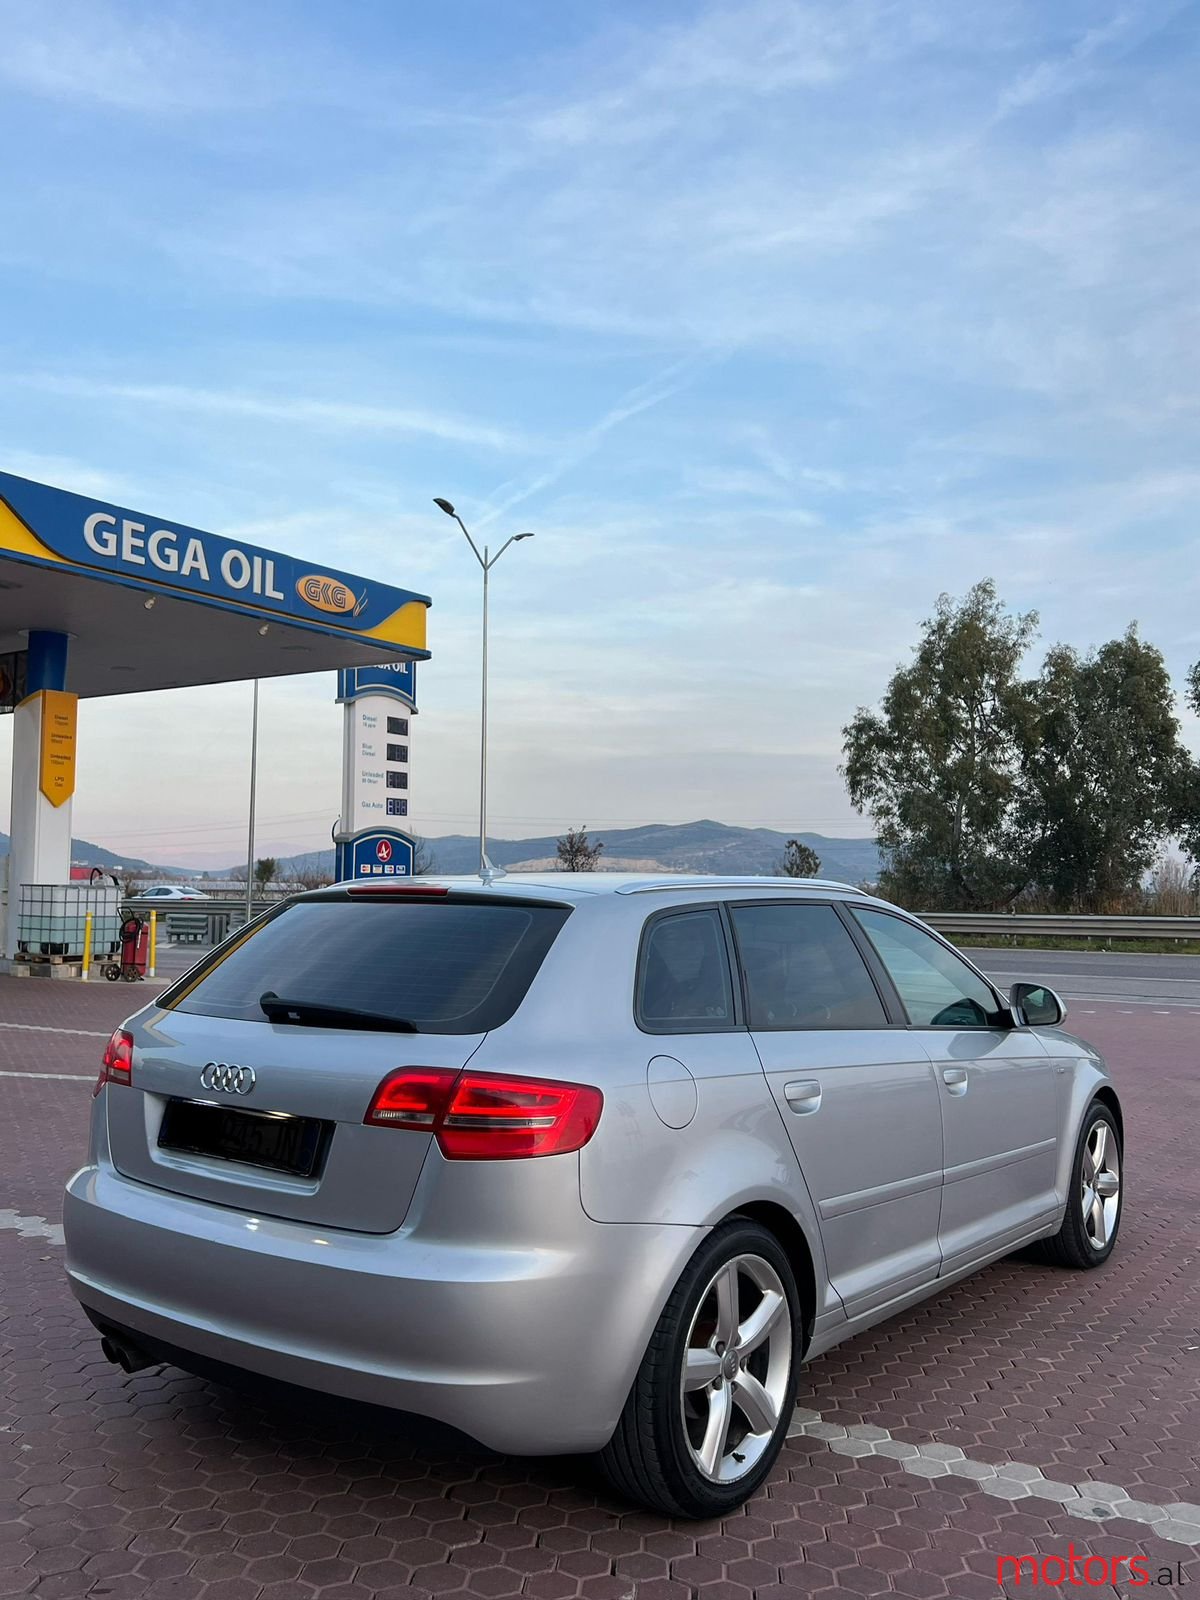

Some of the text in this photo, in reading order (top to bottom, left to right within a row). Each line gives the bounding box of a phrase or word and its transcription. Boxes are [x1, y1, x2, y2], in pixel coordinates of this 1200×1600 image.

[83, 512, 284, 600] GEGA OIL
[304, 578, 346, 608] GKG
[362, 713, 377, 722] Diesel
